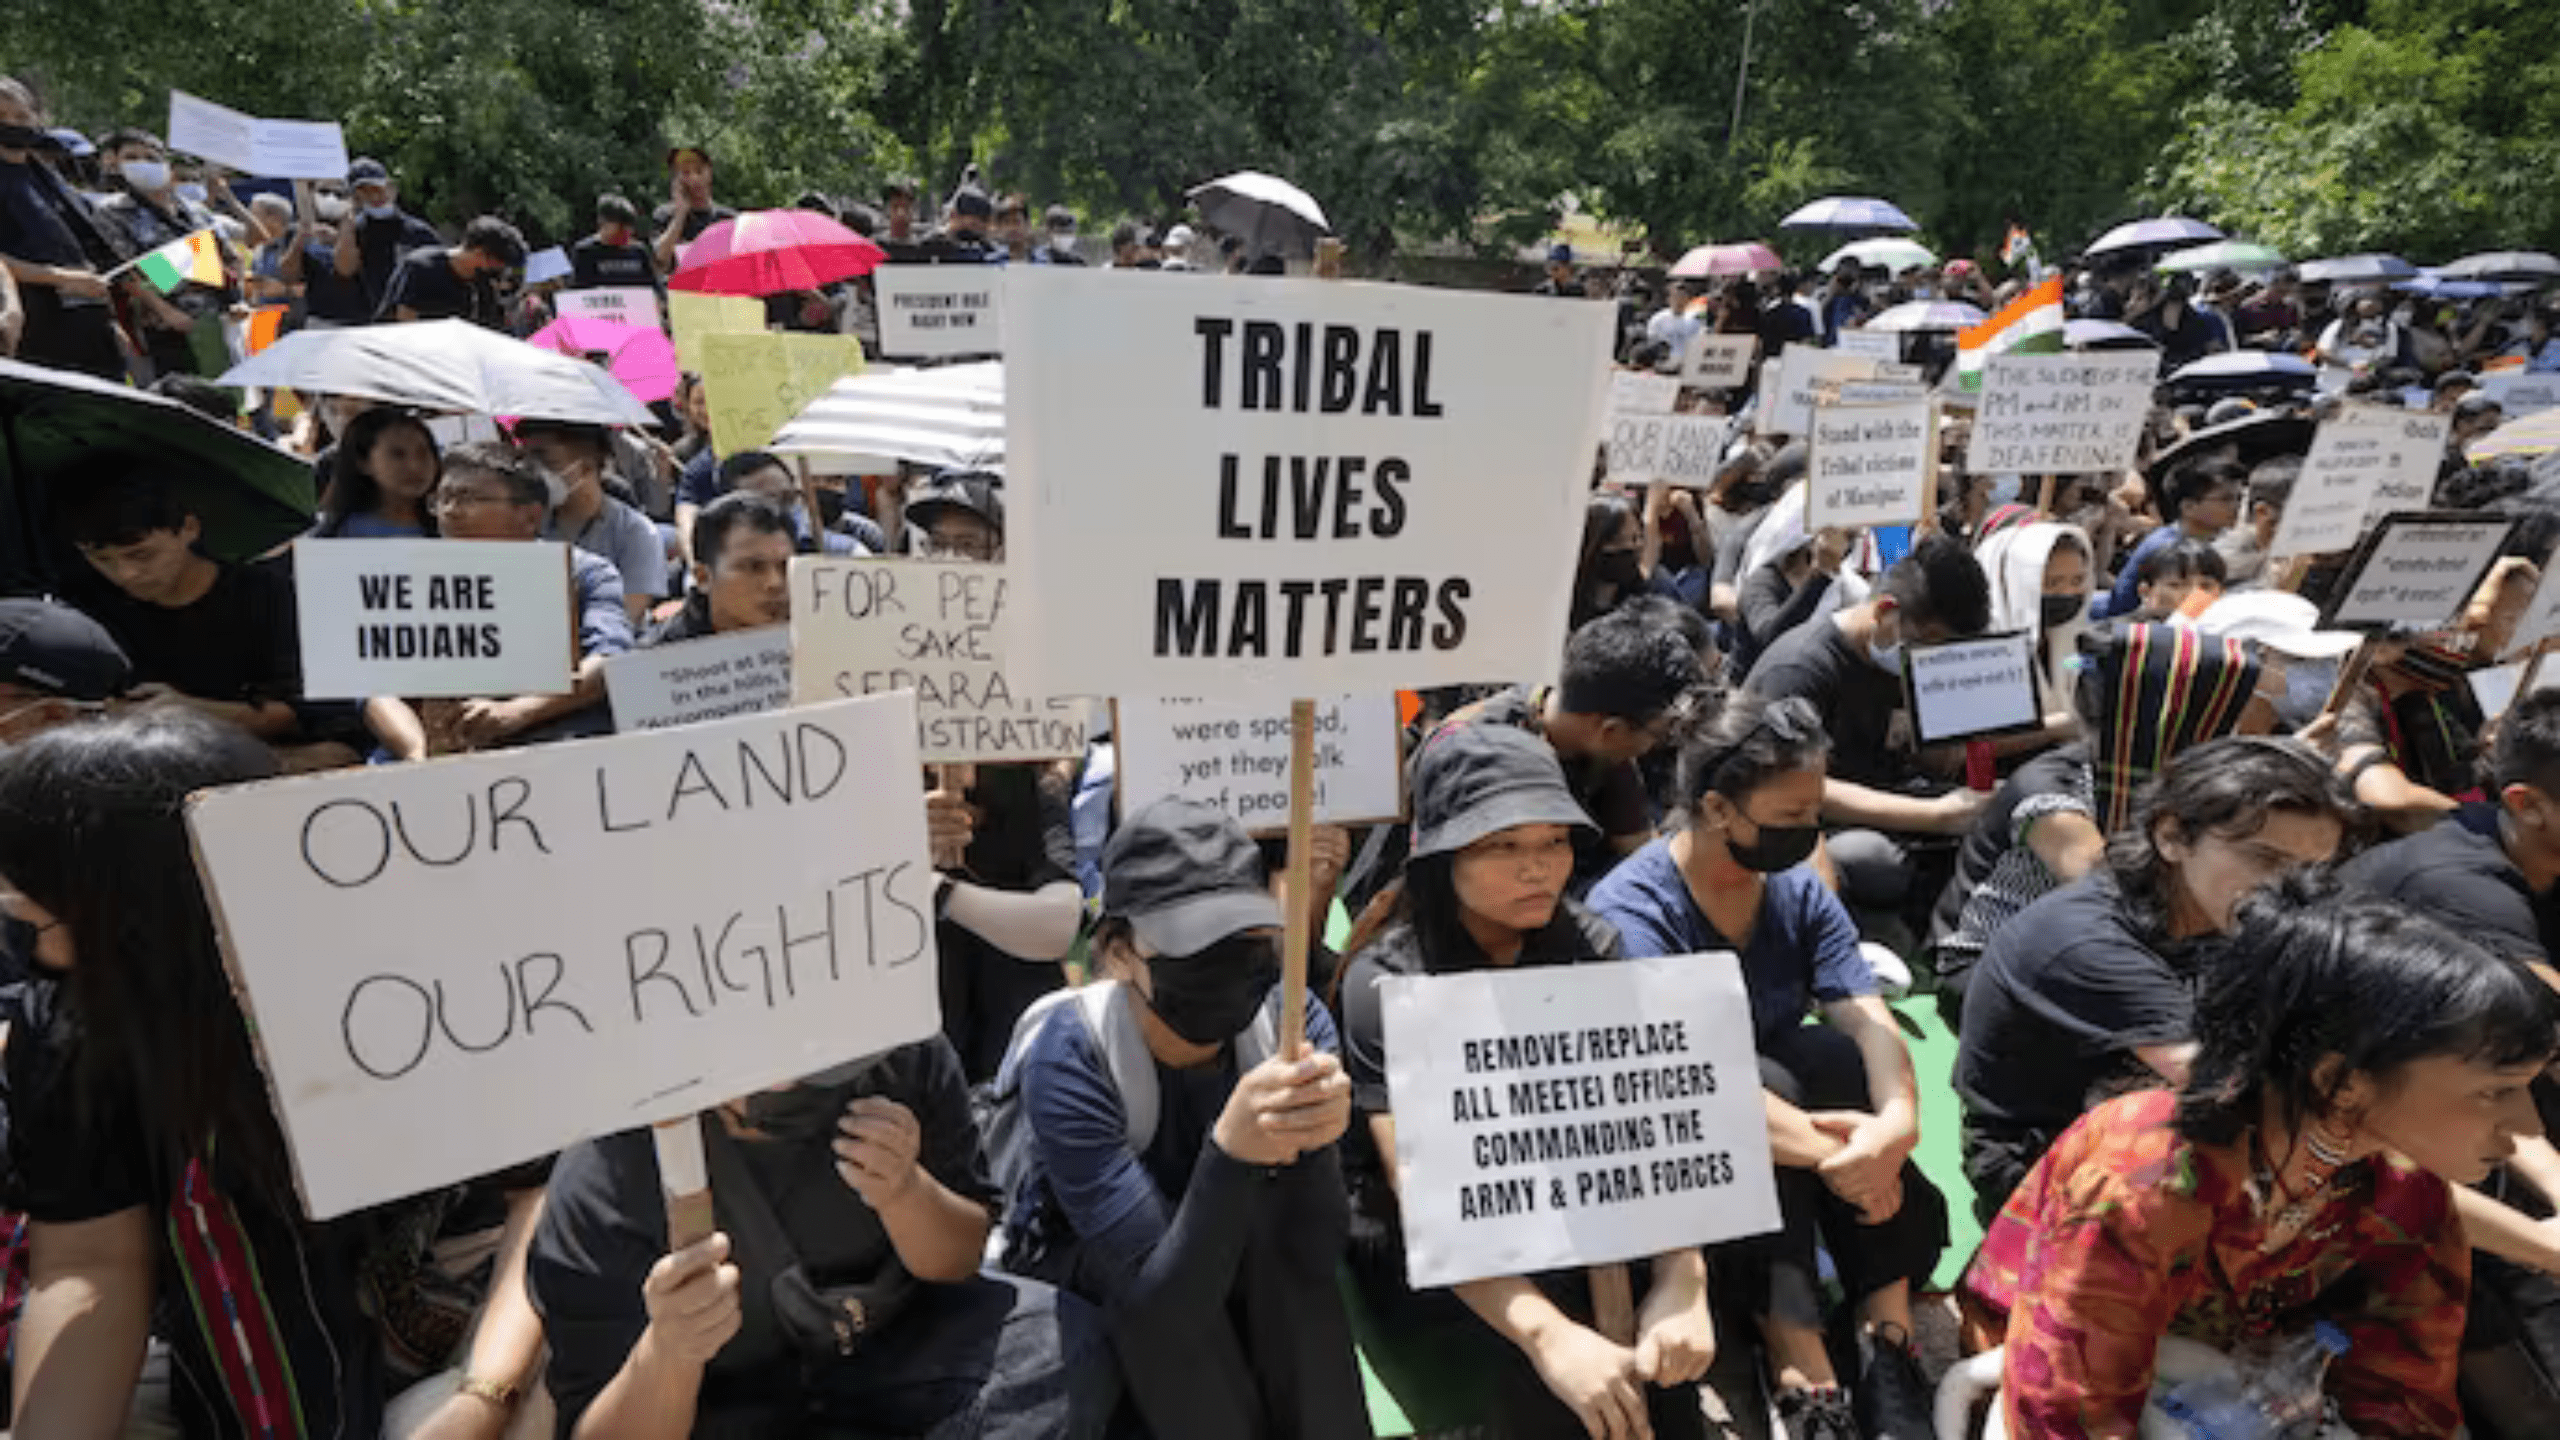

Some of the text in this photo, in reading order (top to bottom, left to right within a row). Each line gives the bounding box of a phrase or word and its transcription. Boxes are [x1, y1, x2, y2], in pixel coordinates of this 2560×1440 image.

[1195, 316, 1444, 418] TRIBAL
[1818, 419, 1919, 444] Stand with the
[1821, 455, 1863, 477] Tribal
[1217, 454, 1411, 540] LIVES
[359, 574, 494, 610] WE ARE
[812, 567, 1006, 623] FOR PEA
[358, 623, 501, 659] INDIANS
[897, 622, 993, 661] SAKE
[1153, 576, 1471, 659] MATTERS
[696, 683, 730, 700] the
[835, 669, 1070, 713] SEPARA
[919, 716, 1085, 752] ISTRATION
[1172, 719, 1240, 741] were
[1179, 756, 1221, 785] yet
[1231, 748, 1287, 777] they
[302, 723, 847, 888] OUR LAND
[341, 861, 927, 1080] OUR RIGHTS
[1463, 1020, 1689, 1074] REMOVE/REPLACE
[1453, 1063, 1716, 1123] ALL MEETEI OFFICERS
[1473, 1109, 1704, 1170] COMMANDING THE
[1460, 1151, 1734, 1222] ARMY & PARA FORCES
